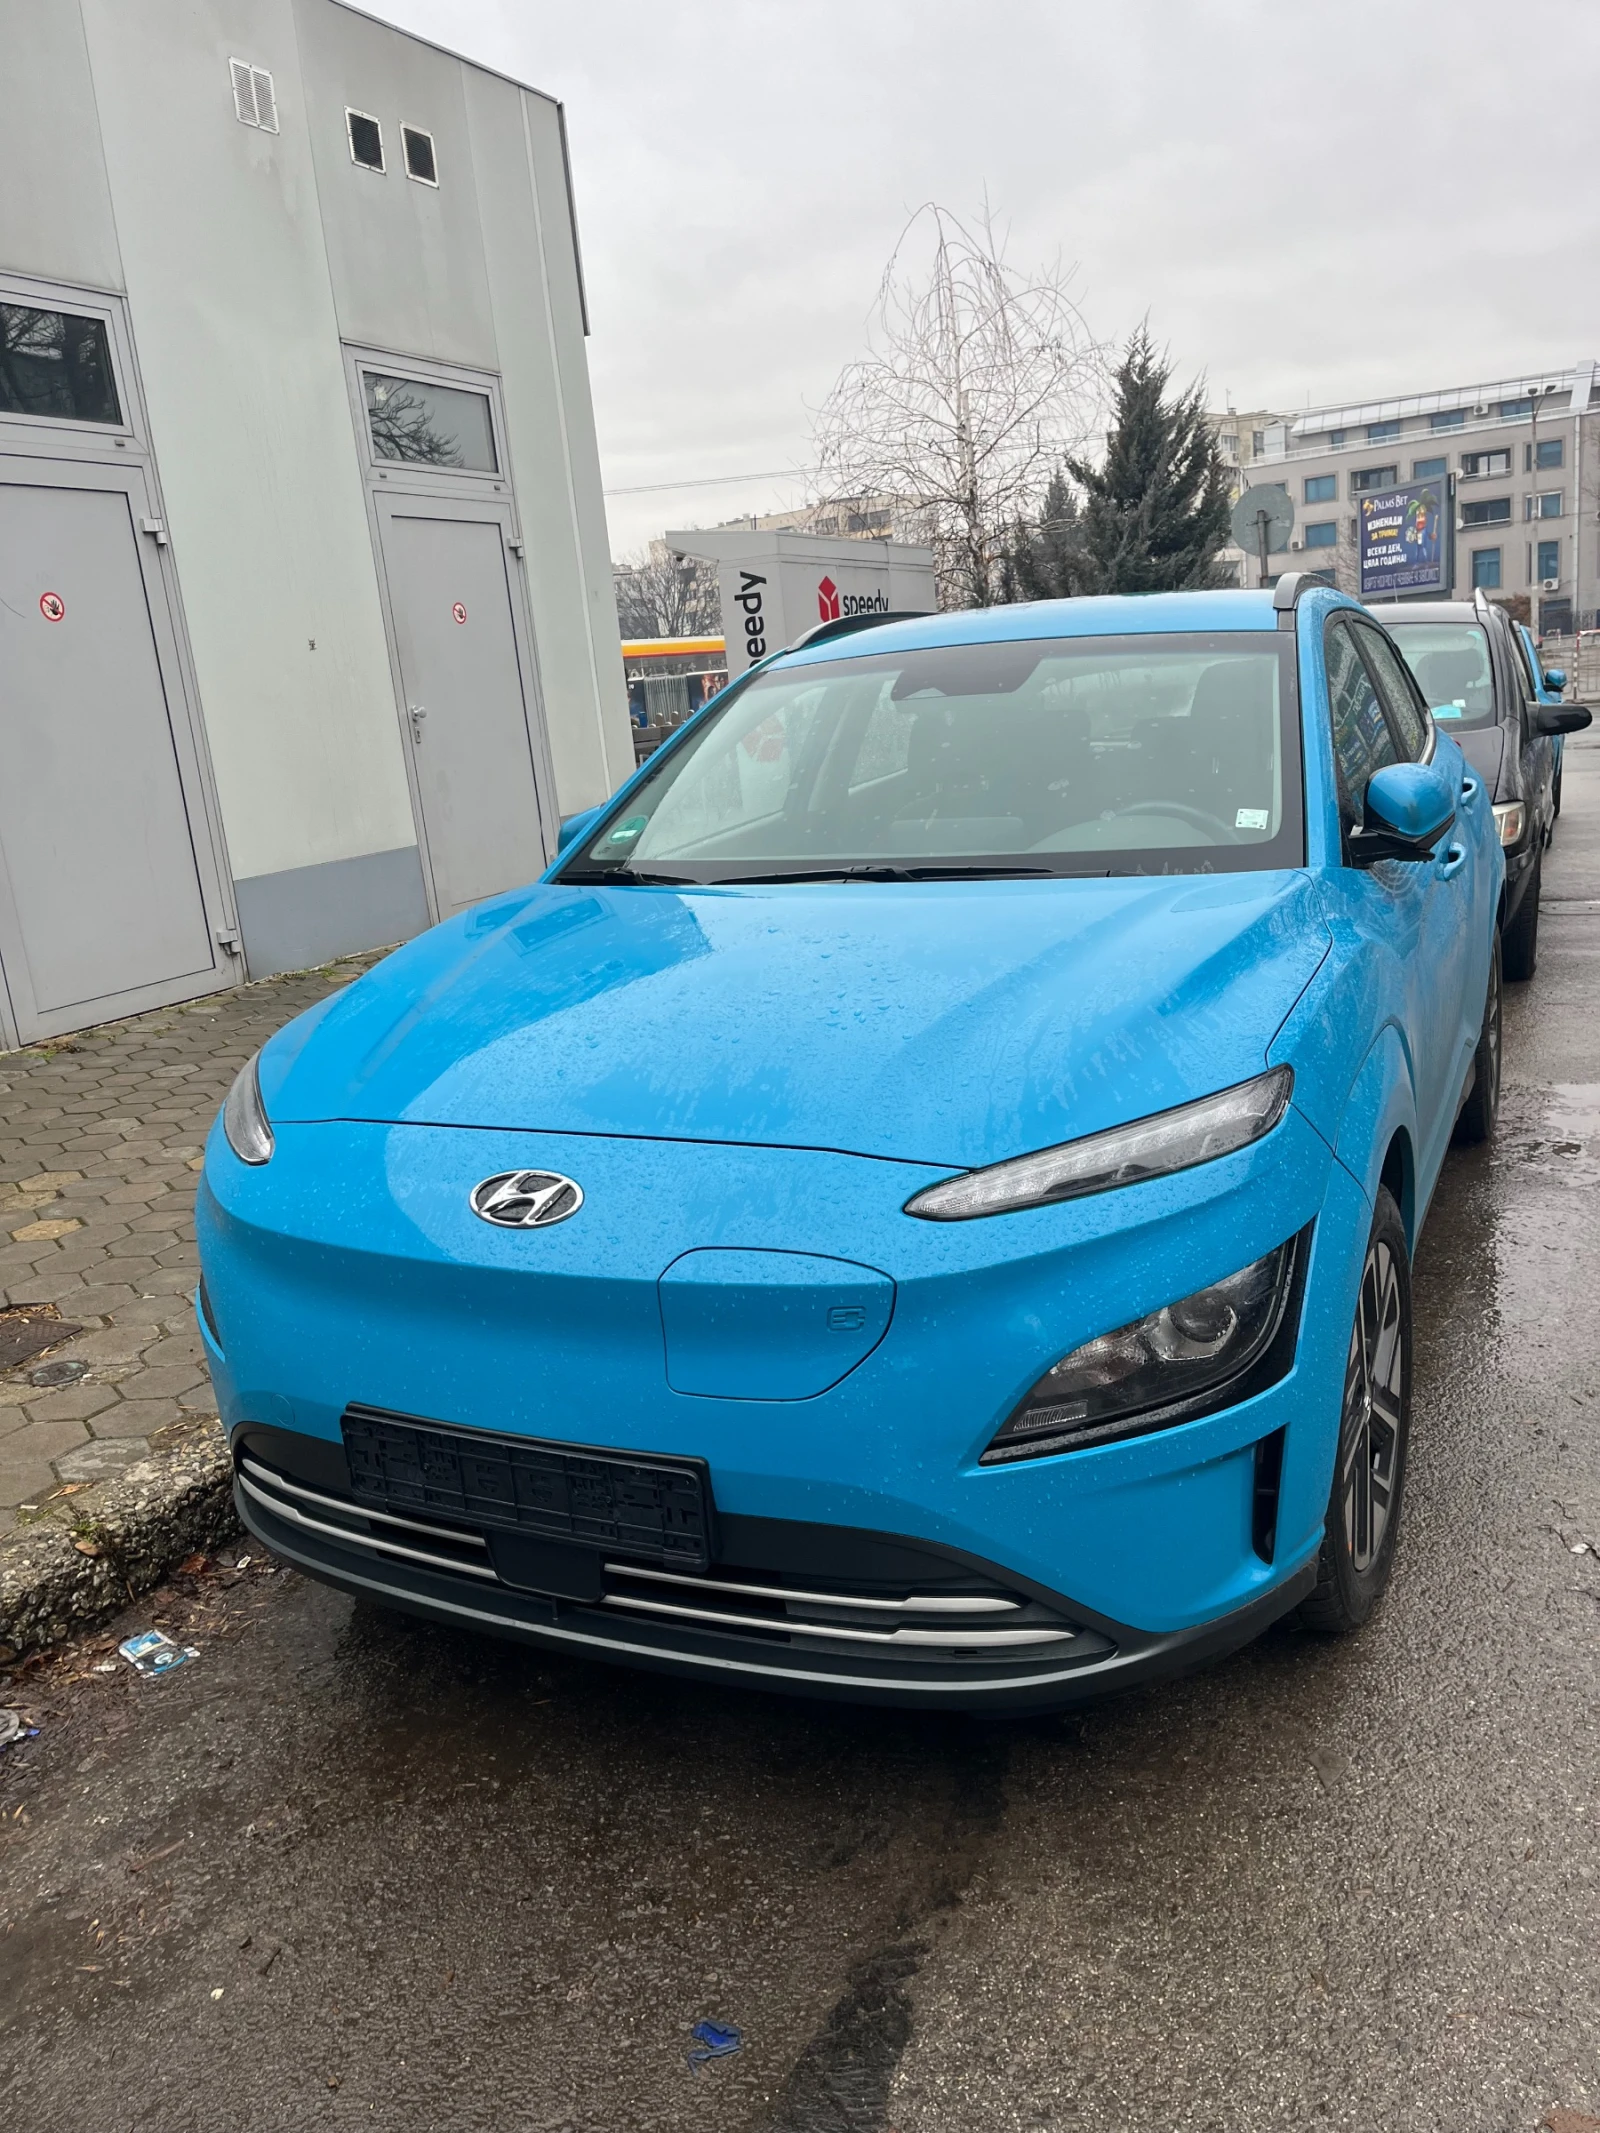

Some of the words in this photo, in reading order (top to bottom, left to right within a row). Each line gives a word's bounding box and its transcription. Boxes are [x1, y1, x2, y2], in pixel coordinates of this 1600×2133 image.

[1367, 546, 1386, 556] ВСЕКИ
[1388, 543, 1402, 553] ДЕН,
[1363, 558, 1379, 569] ЦЯЛА
[1380, 554, 1407, 565] ГОДИНА!
[734, 571, 767, 668] eedy
